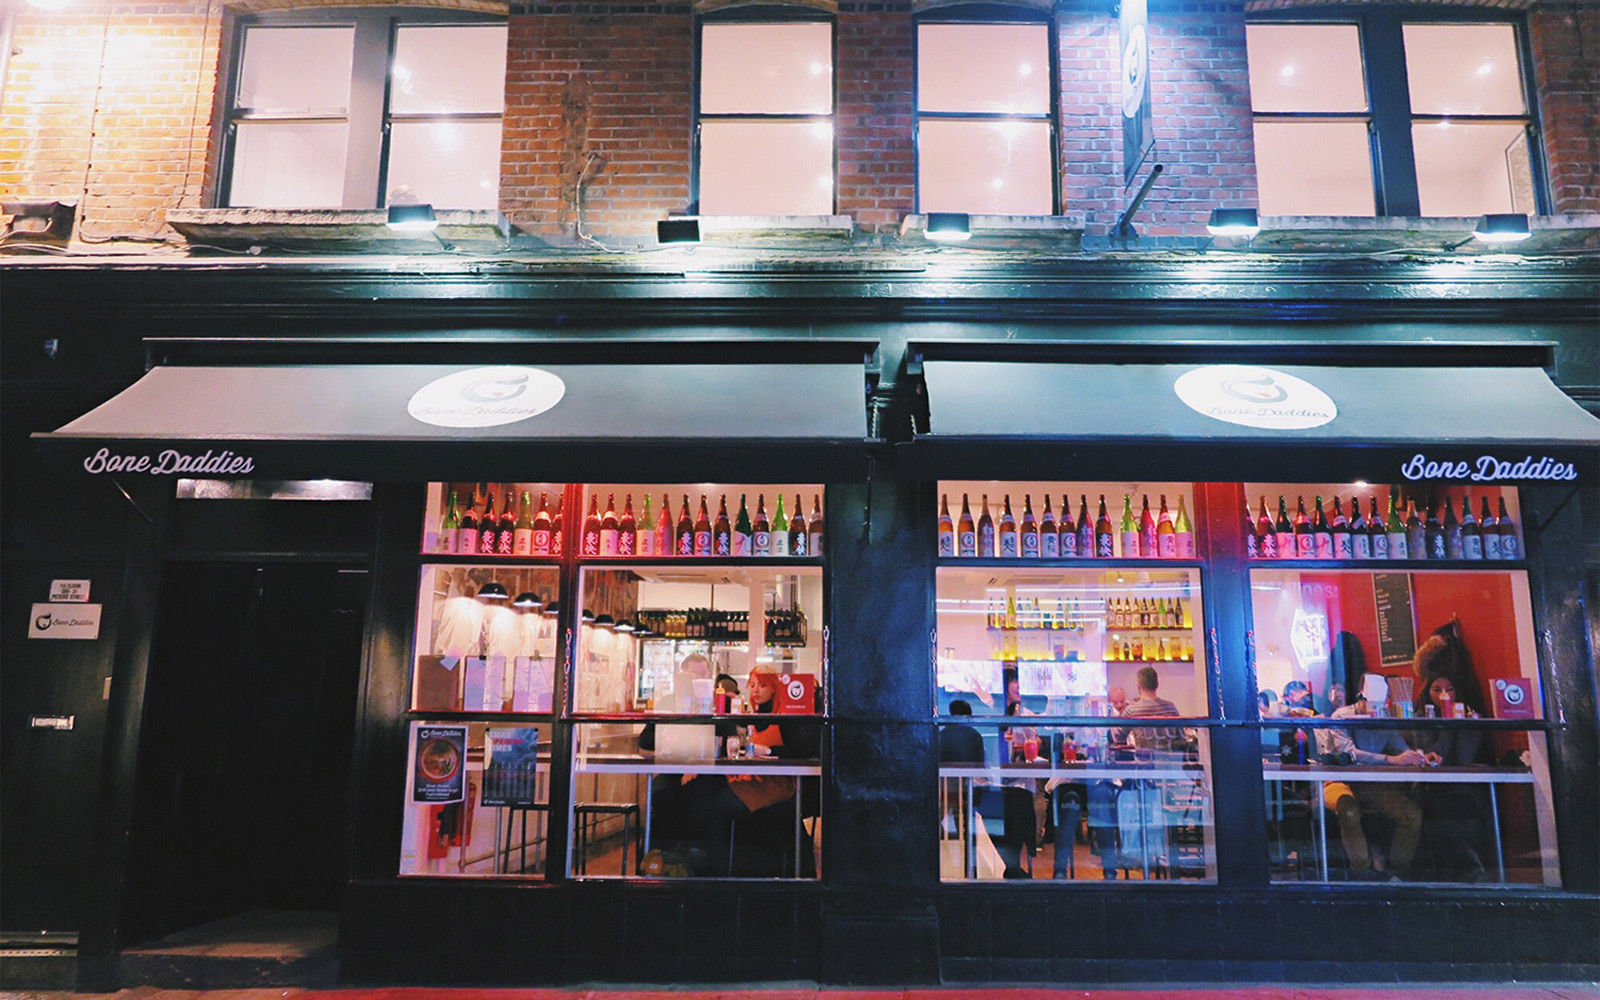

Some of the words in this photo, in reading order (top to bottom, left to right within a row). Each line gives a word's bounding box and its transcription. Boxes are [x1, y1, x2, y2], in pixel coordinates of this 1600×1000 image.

[1205, 406, 1255, 416] Bone
[1257, 408, 1330, 419] Daddies
[84, 447, 152, 474] Bone
[150, 449, 255, 475] Daddies
[1401, 453, 1471, 481] Bone
[1471, 455, 1578, 481] Daddies
